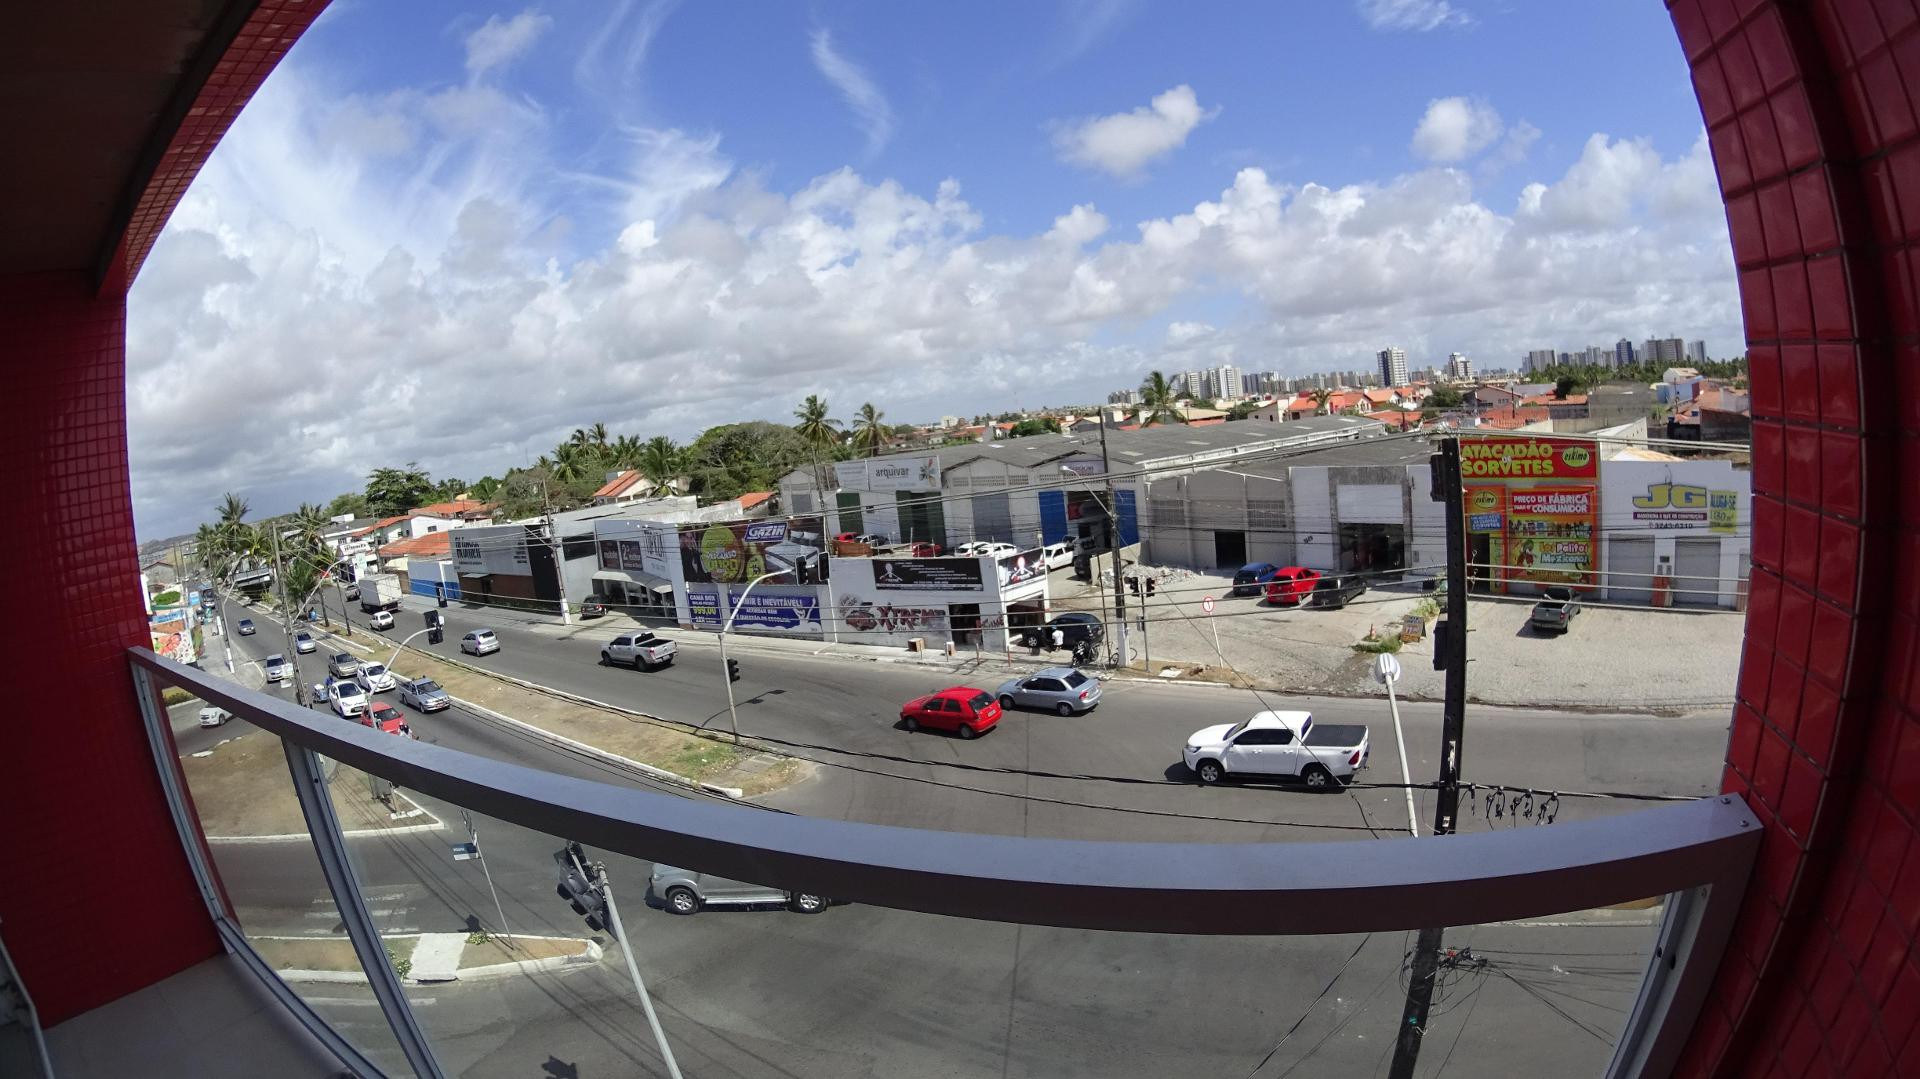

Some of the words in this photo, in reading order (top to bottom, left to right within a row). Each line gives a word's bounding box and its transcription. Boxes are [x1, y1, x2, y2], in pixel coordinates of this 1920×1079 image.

[1461, 441, 1553, 459] ATACADÃO
[875, 467, 909, 478] arquivar
[1461, 460, 1554, 475] SORVETES
[1513, 495, 1536, 505] PREÇO
[1548, 493, 1588, 505] FÁBRICA
[1532, 504, 1587, 513] CONSUMIDOR
[1556, 542, 1588, 553] Palitos
[732, 596, 756, 605] DOMIR
[762, 597, 802, 607] INEVITÁVEL!
